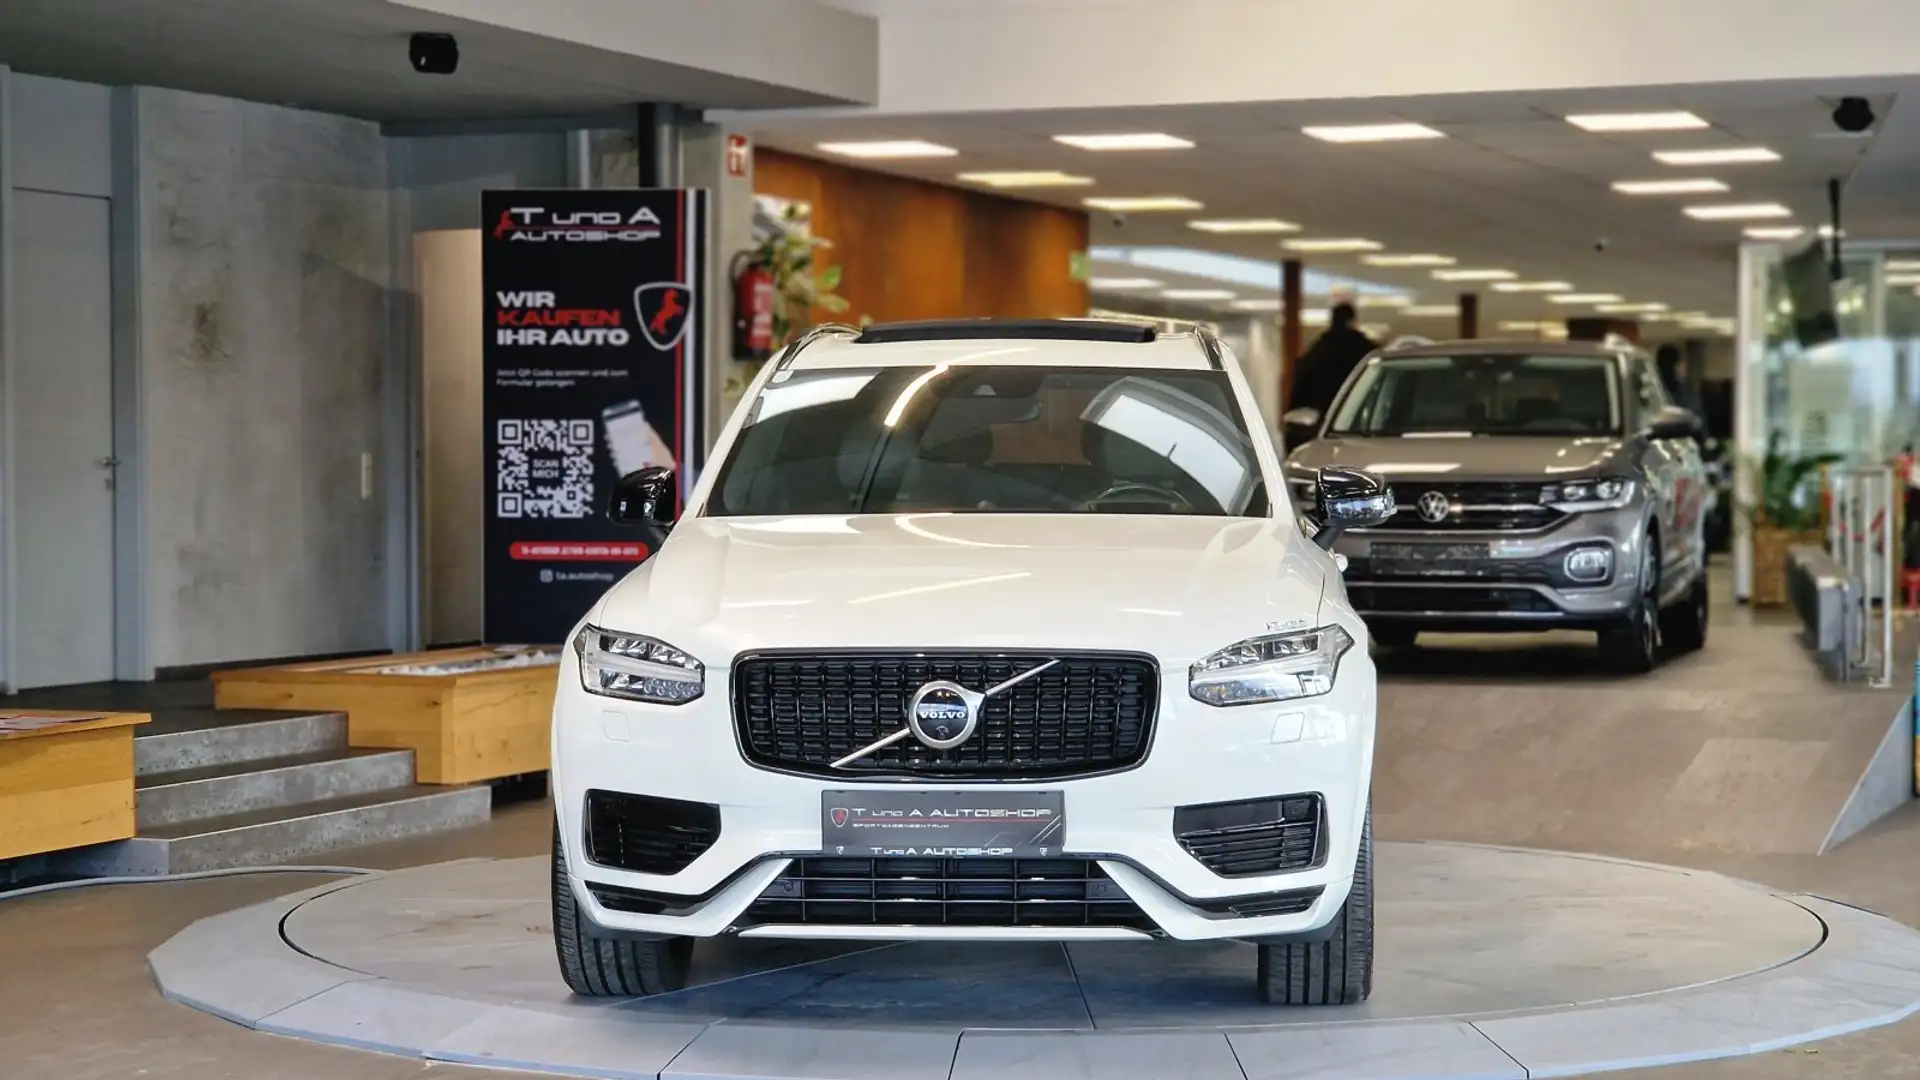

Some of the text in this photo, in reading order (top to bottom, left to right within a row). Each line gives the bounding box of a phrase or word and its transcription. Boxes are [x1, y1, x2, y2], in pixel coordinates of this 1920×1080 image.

[510, 207, 545, 224] T
[628, 206, 661, 225] A
[510, 230, 661, 241] AUTOSHOP
[497, 291, 555, 308] WIR
[497, 309, 621, 326] KAUFEN
[497, 328, 630, 346] IHR AUTO
[533, 459, 559, 468] SCAN
[532, 469, 559, 479] MICH
[919, 711, 966, 719] VOLVO
[852, 808, 867, 817] T
[909, 808, 923, 817] A
[930, 808, 1052, 818] AUTOSHOP
[923, 847, 1013, 856] AUTOSHOP
